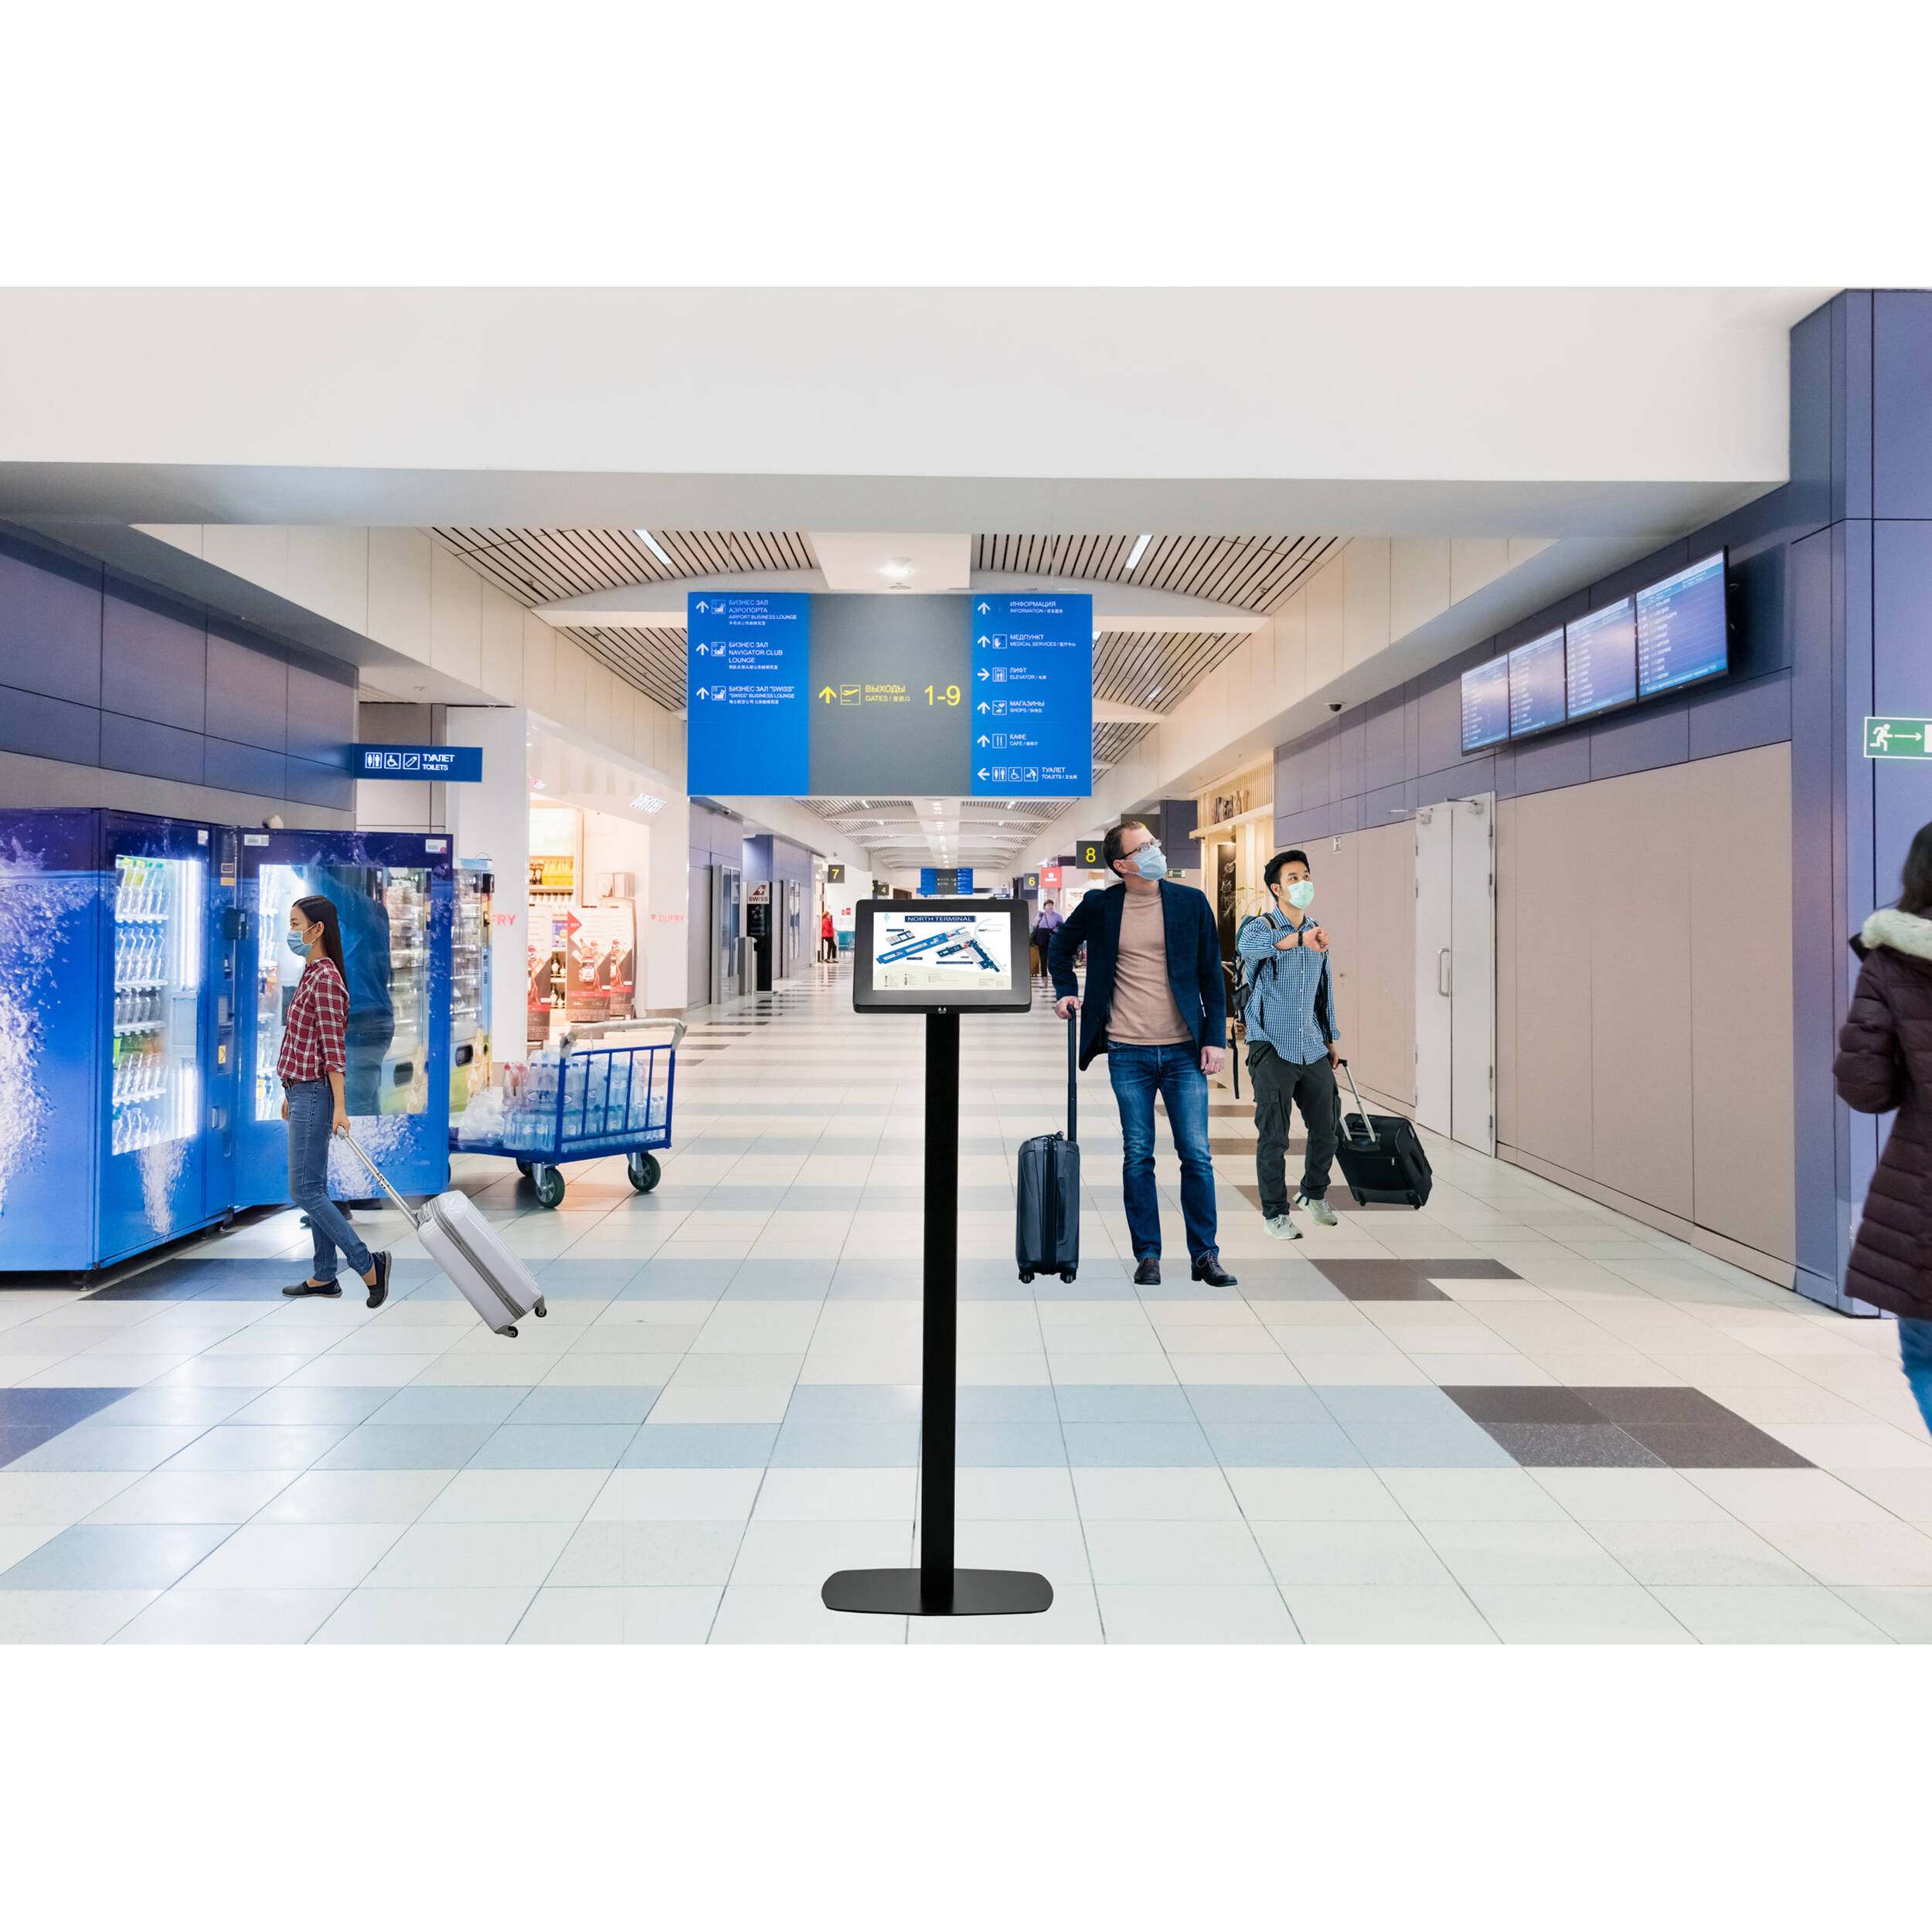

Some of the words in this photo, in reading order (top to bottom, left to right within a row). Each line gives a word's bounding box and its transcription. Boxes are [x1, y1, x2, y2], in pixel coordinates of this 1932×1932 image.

[866, 685, 906, 694] ВЫХОДЫ
[924, 685, 961, 706] 1-9
[423, 753, 455, 763] ТУАЛЕТ
[1086, 847, 1096, 863] 8
[832, 869, 839, 879] 7
[1029, 876, 1036, 886] 6
